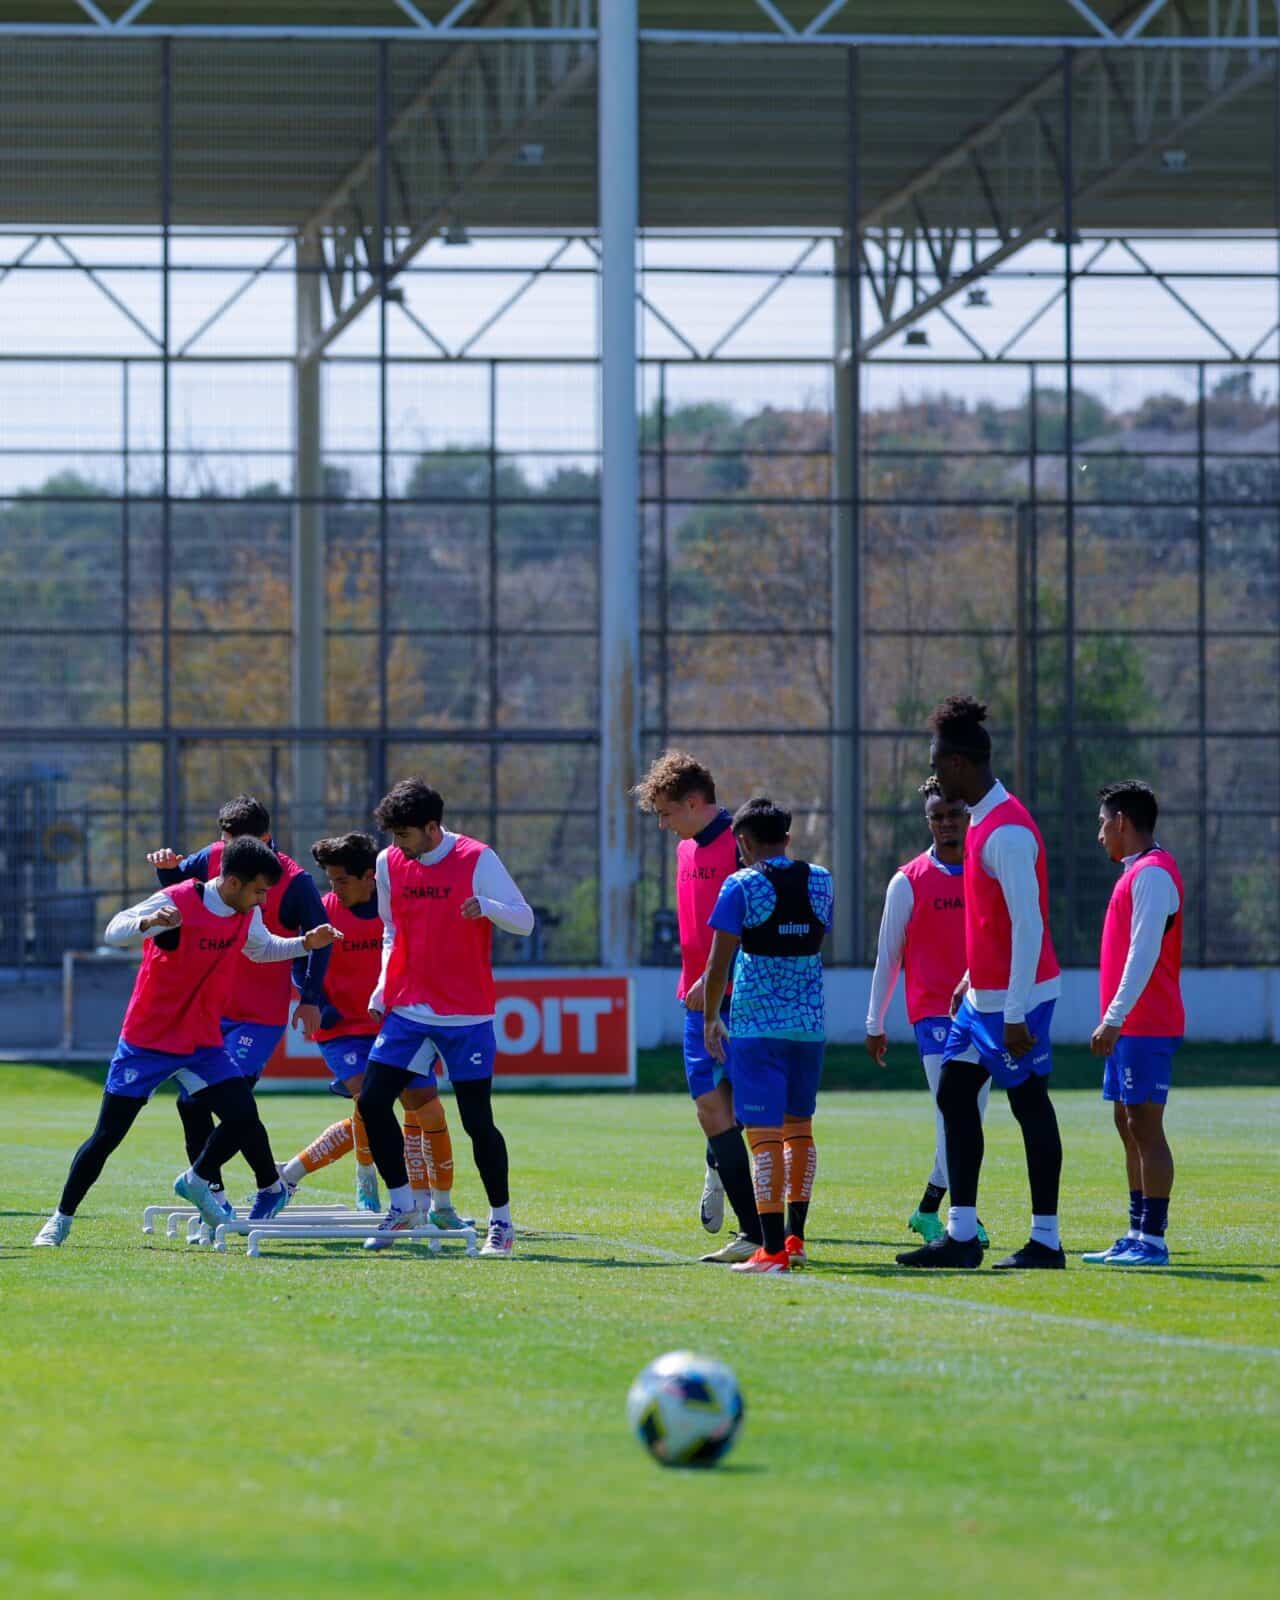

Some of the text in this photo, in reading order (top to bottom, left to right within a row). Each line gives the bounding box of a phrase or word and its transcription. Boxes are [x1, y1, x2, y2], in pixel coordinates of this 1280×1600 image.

[680, 866, 717, 881] CHARLY
[401, 886, 452, 899] CHARLY
[933, 897, 966, 911] CHA
